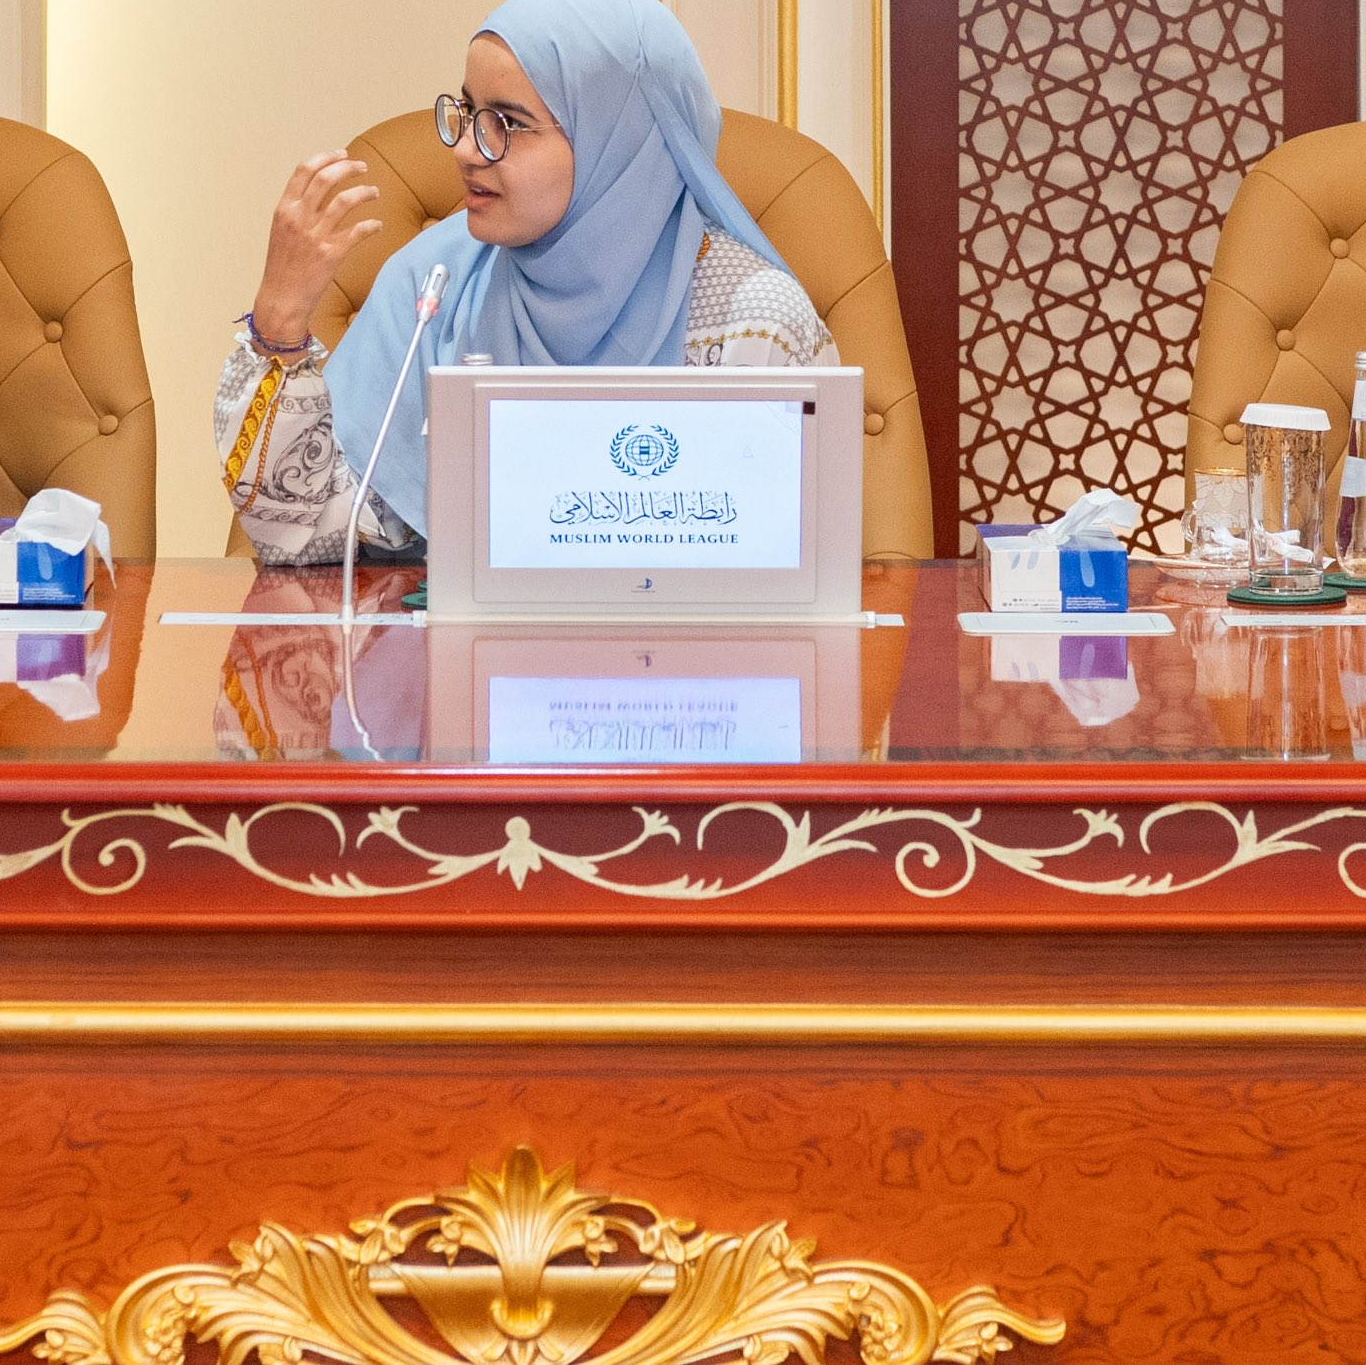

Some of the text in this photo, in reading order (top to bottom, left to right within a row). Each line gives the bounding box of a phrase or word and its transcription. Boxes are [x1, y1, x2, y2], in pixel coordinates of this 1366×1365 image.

[549, 533, 739, 544] MUSLIM WORLD LEAGUE
